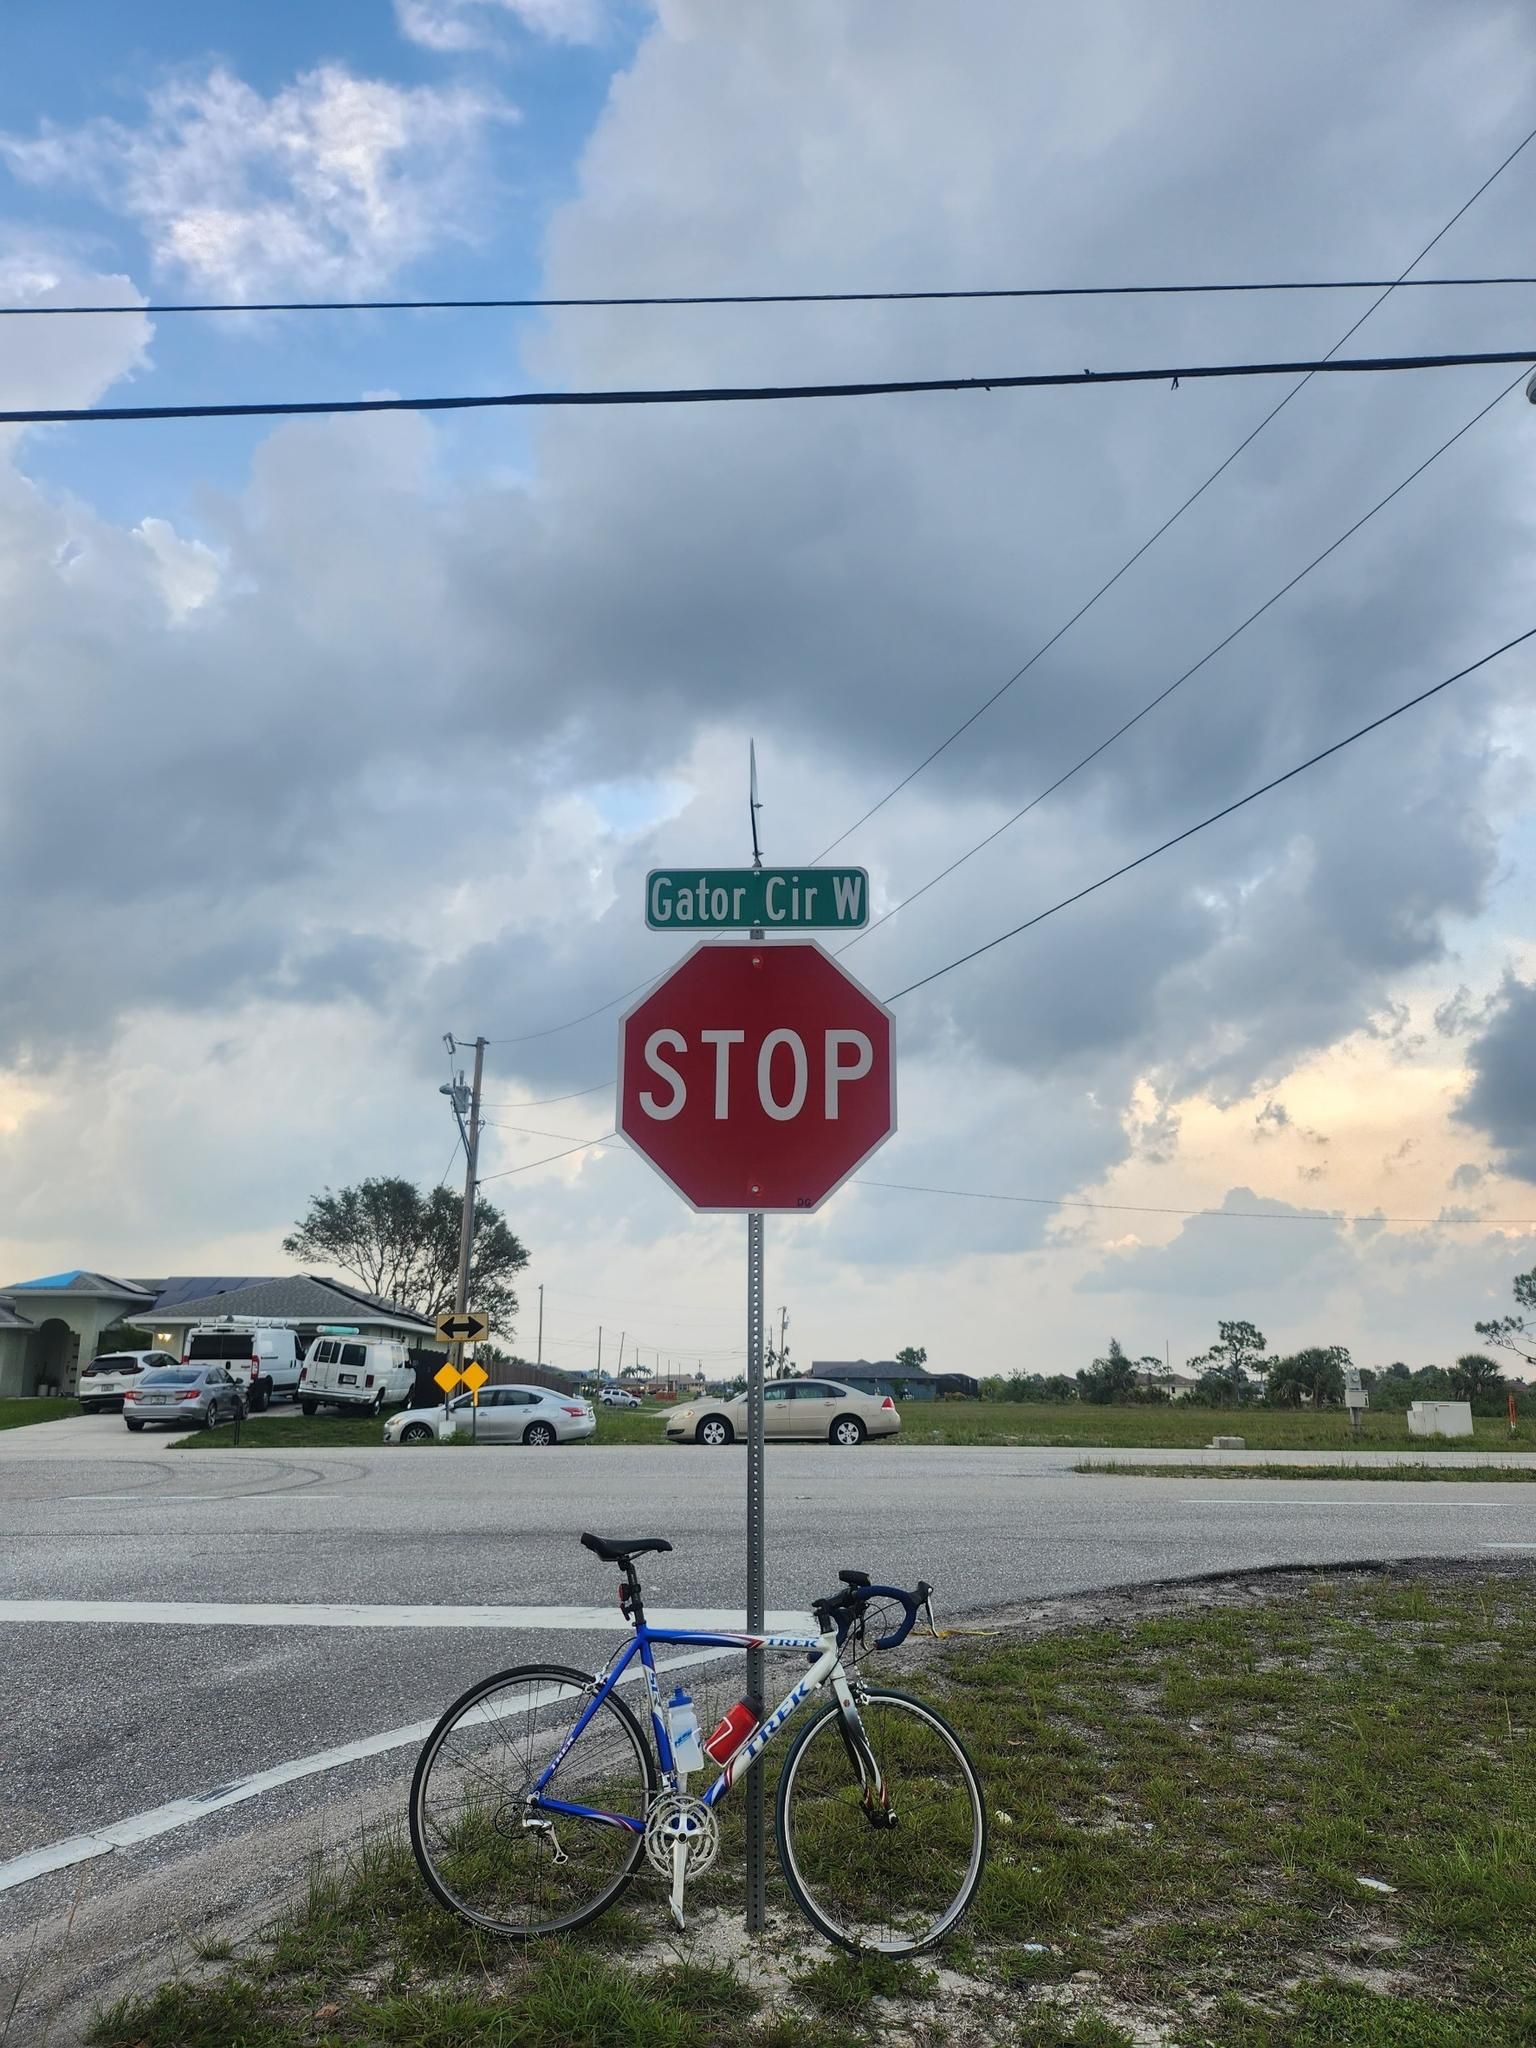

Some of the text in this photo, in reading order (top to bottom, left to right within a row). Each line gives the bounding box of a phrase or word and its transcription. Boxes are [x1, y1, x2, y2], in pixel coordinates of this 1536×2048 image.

[651, 876, 862, 921] Gator Cir W
[639, 1028, 874, 1121] STOP
[767, 1637, 818, 1648] TREK
[742, 1681, 811, 1760] TREK
